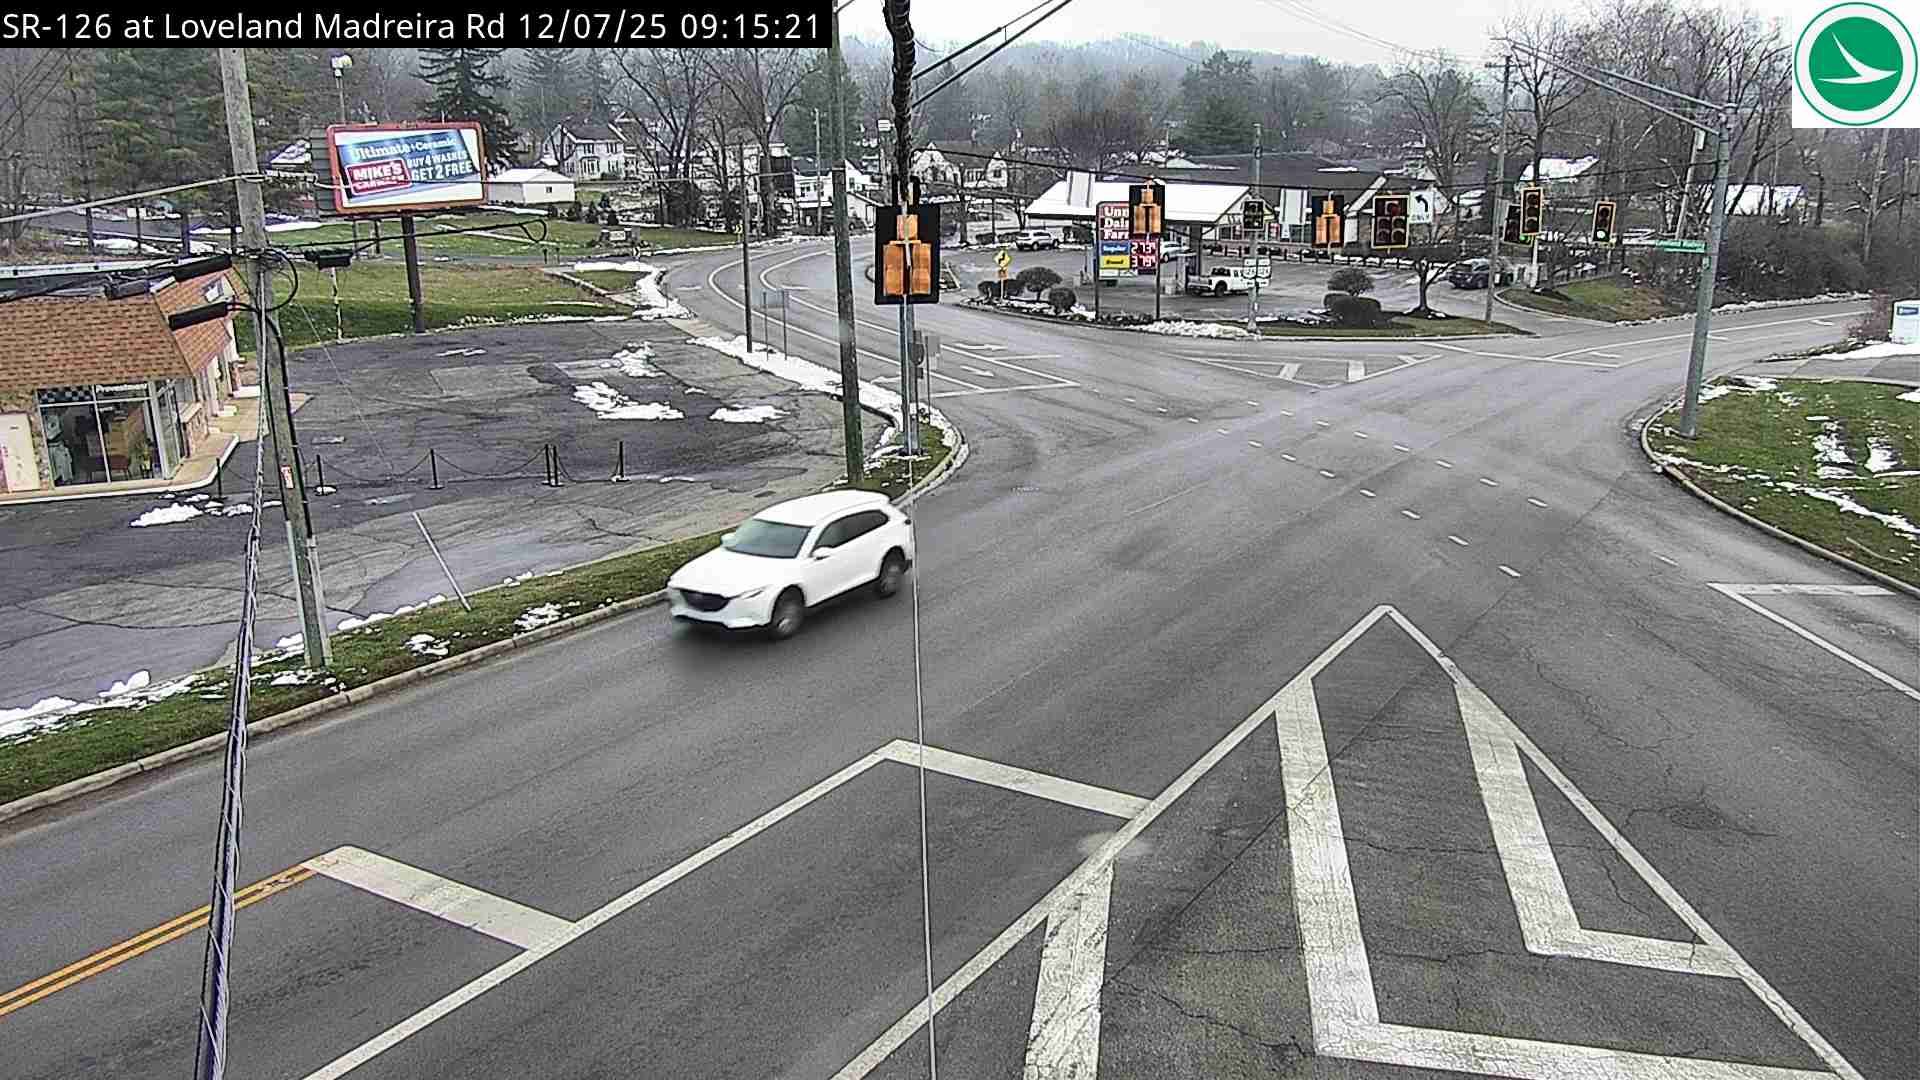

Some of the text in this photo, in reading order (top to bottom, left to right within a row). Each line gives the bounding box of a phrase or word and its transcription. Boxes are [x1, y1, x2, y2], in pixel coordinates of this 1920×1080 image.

[352, 162, 402, 181] MIKE'S
[406, 158, 425, 168] BUY
[425, 157, 431, 167] 4
[411, 160, 473, 181] GET 2 FREE
